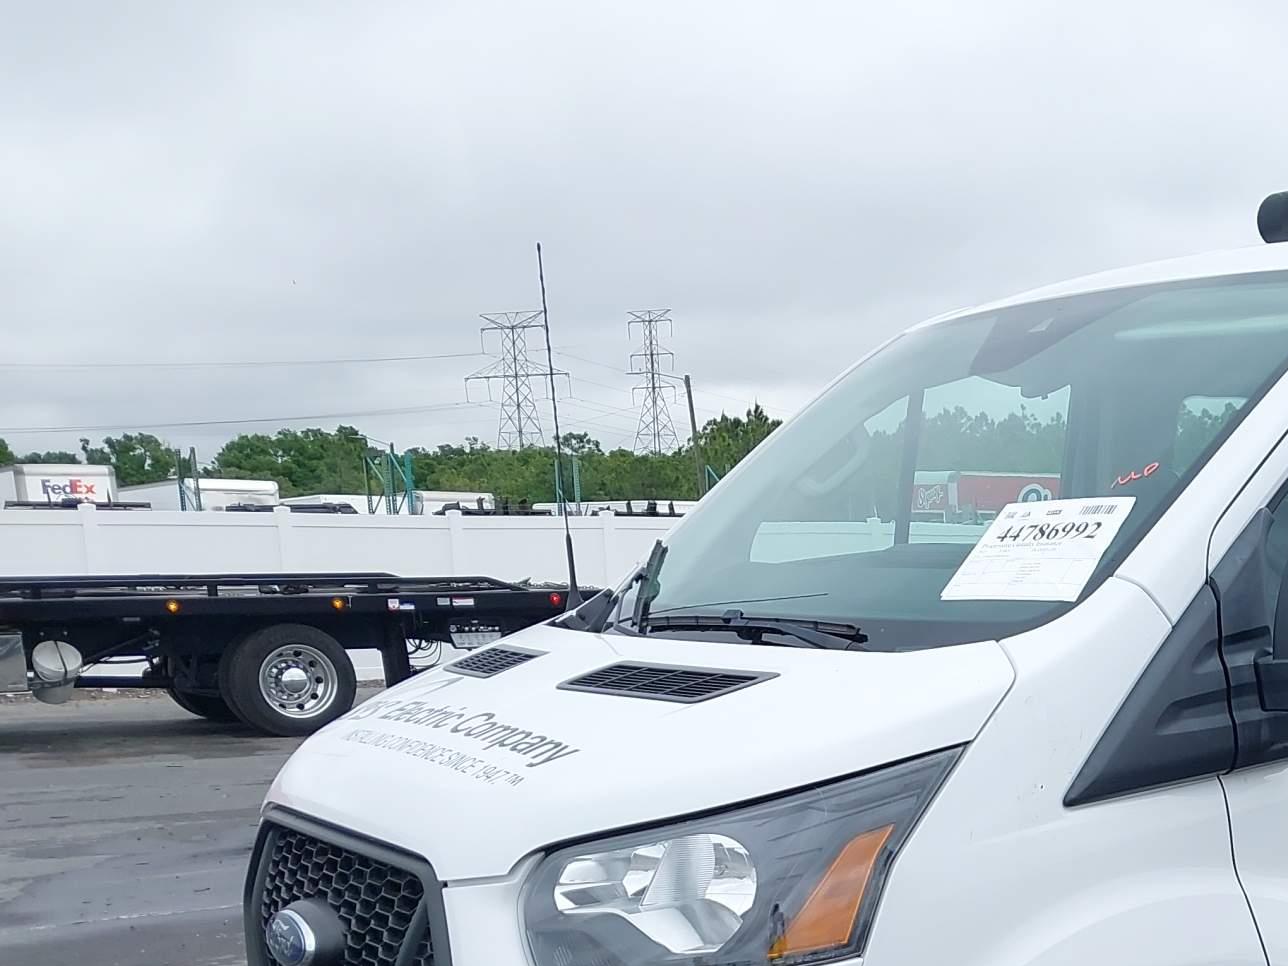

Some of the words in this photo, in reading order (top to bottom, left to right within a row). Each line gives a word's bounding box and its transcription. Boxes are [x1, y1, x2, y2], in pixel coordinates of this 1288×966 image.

[41, 479, 96, 495] FedEx
[996, 521, 1103, 542] 44786992
[378, 700, 468, 729] Electric
[450, 712, 581, 768] Company
